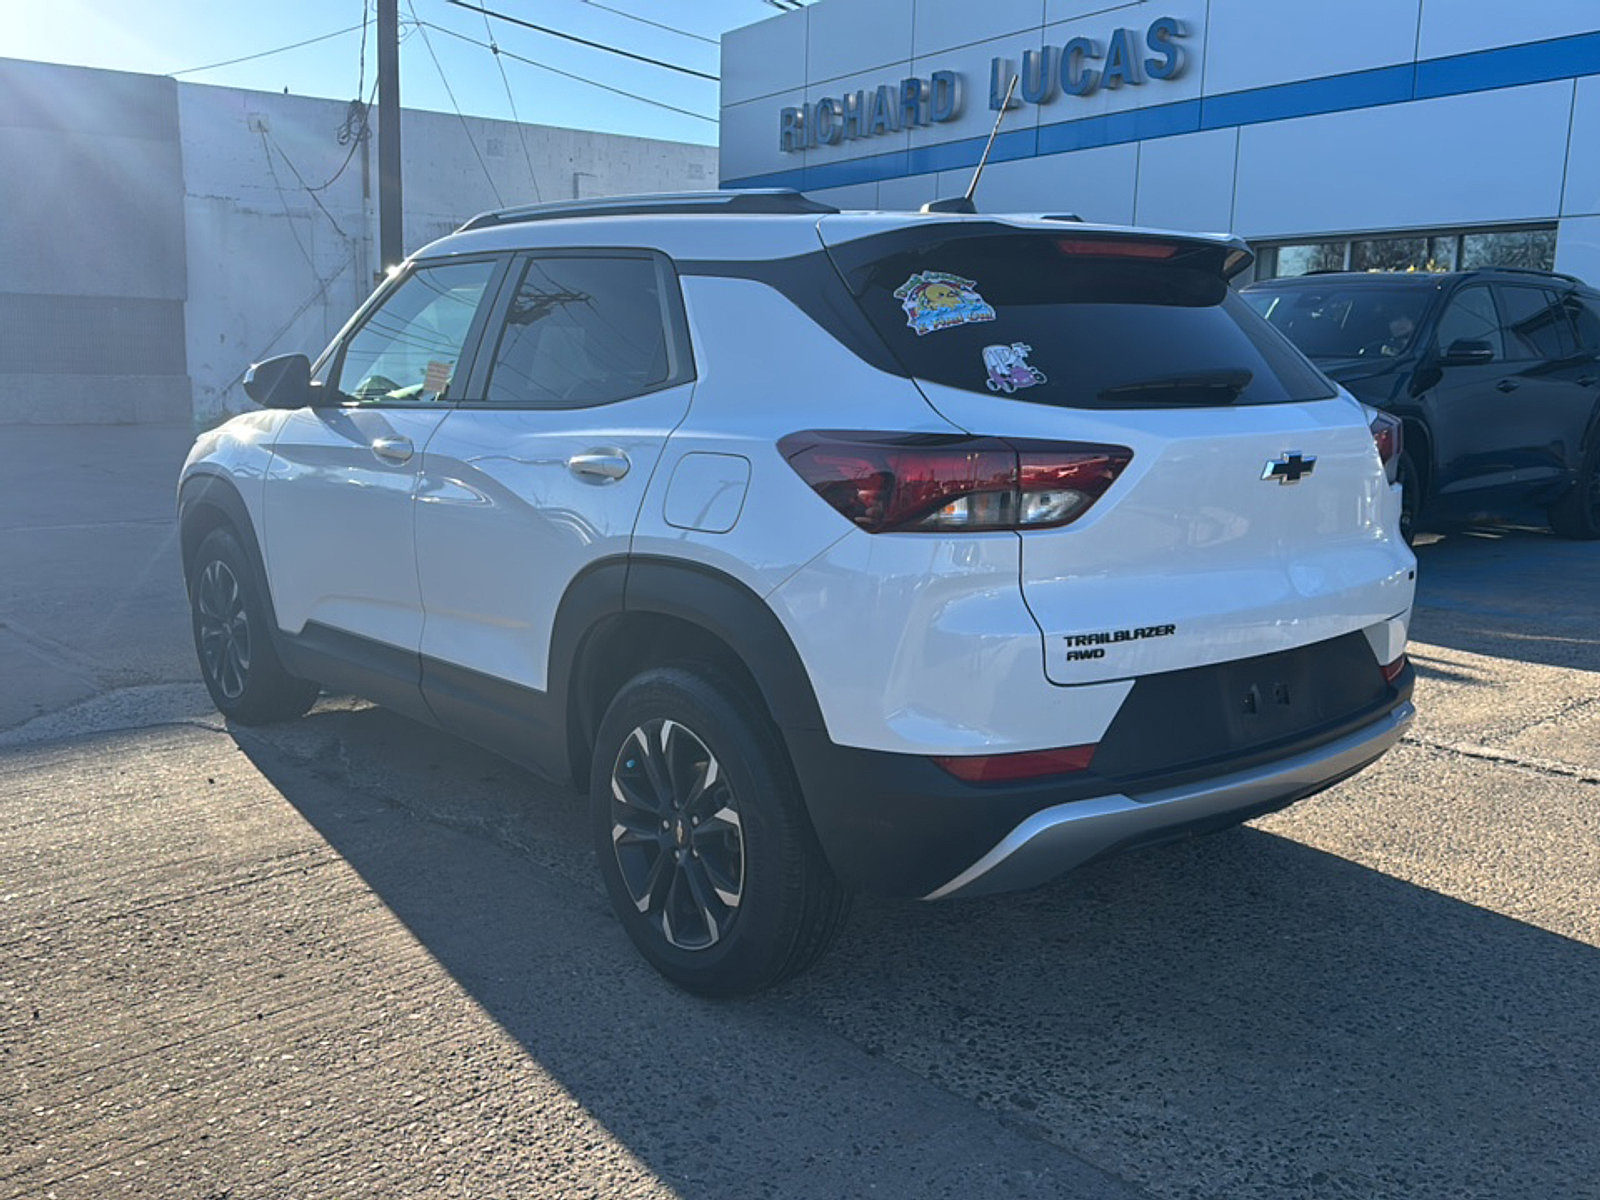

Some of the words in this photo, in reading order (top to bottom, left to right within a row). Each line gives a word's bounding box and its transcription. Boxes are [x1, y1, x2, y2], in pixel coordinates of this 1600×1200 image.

[780, 70, 963, 152] RICHARD
[989, 17, 1187, 110] LUCAS
[1064, 624, 1175, 647] TRAILBLAZER
[1066, 648, 1105, 661] AWD
